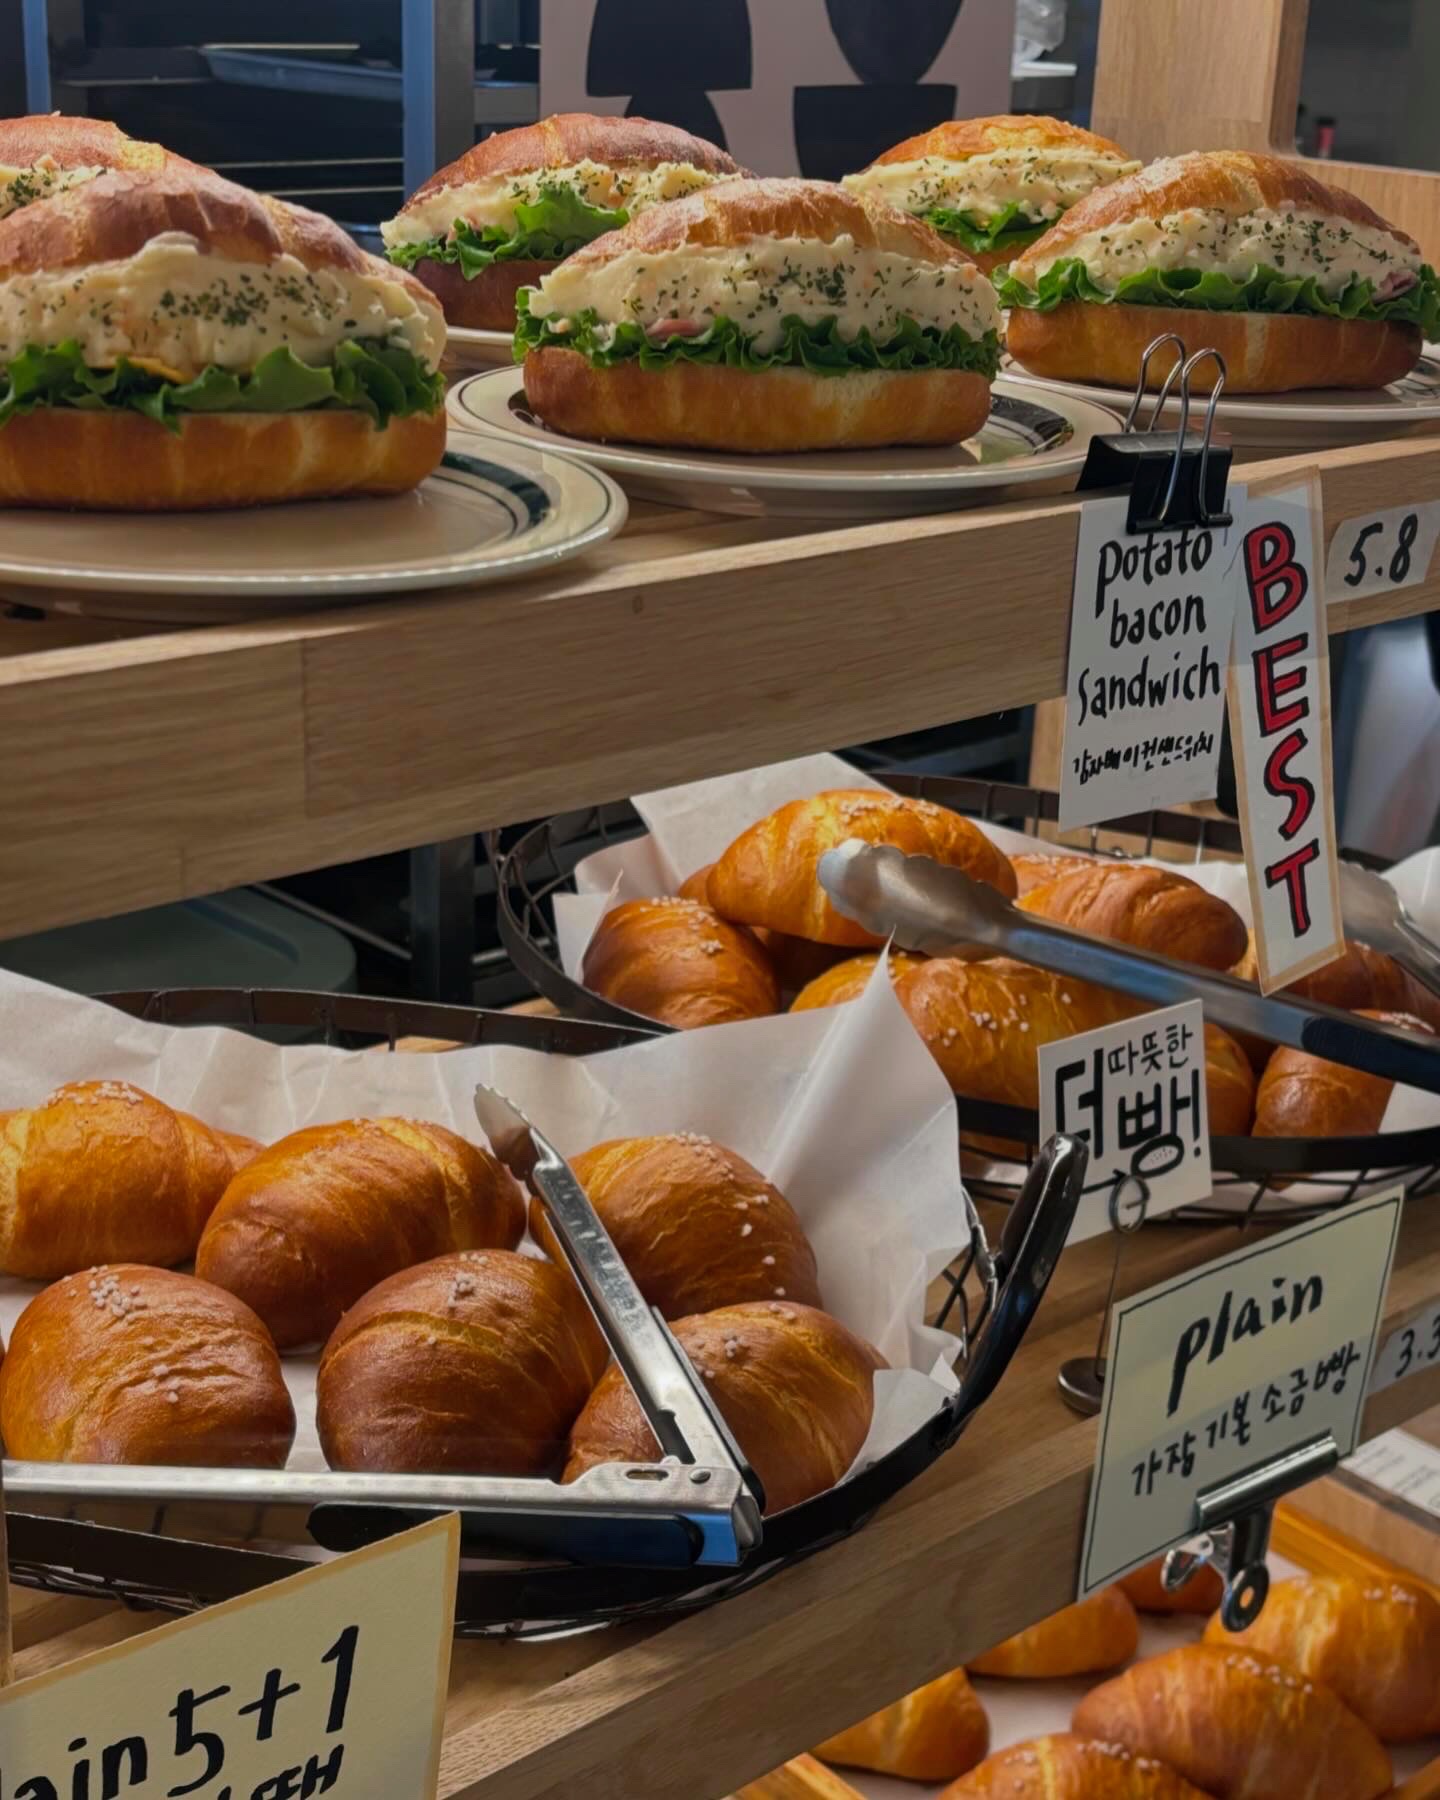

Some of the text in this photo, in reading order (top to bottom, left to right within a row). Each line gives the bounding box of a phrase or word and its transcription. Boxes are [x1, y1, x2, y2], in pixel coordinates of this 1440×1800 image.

[1095, 530, 1213, 619] potato
[1343, 513, 1419, 587] 5.8
[1109, 593, 1207, 649] bacon
[1242, 520, 1320, 938] BEST
[1107, 1023, 1194, 1077] 따뜻한
[1117, 1068, 1201, 1179] 빵!
[1166, 1275, 1323, 1418] plain
[1131, 1430, 1196, 1496] 가장
[1205, 1390, 1251, 1446] 기본
